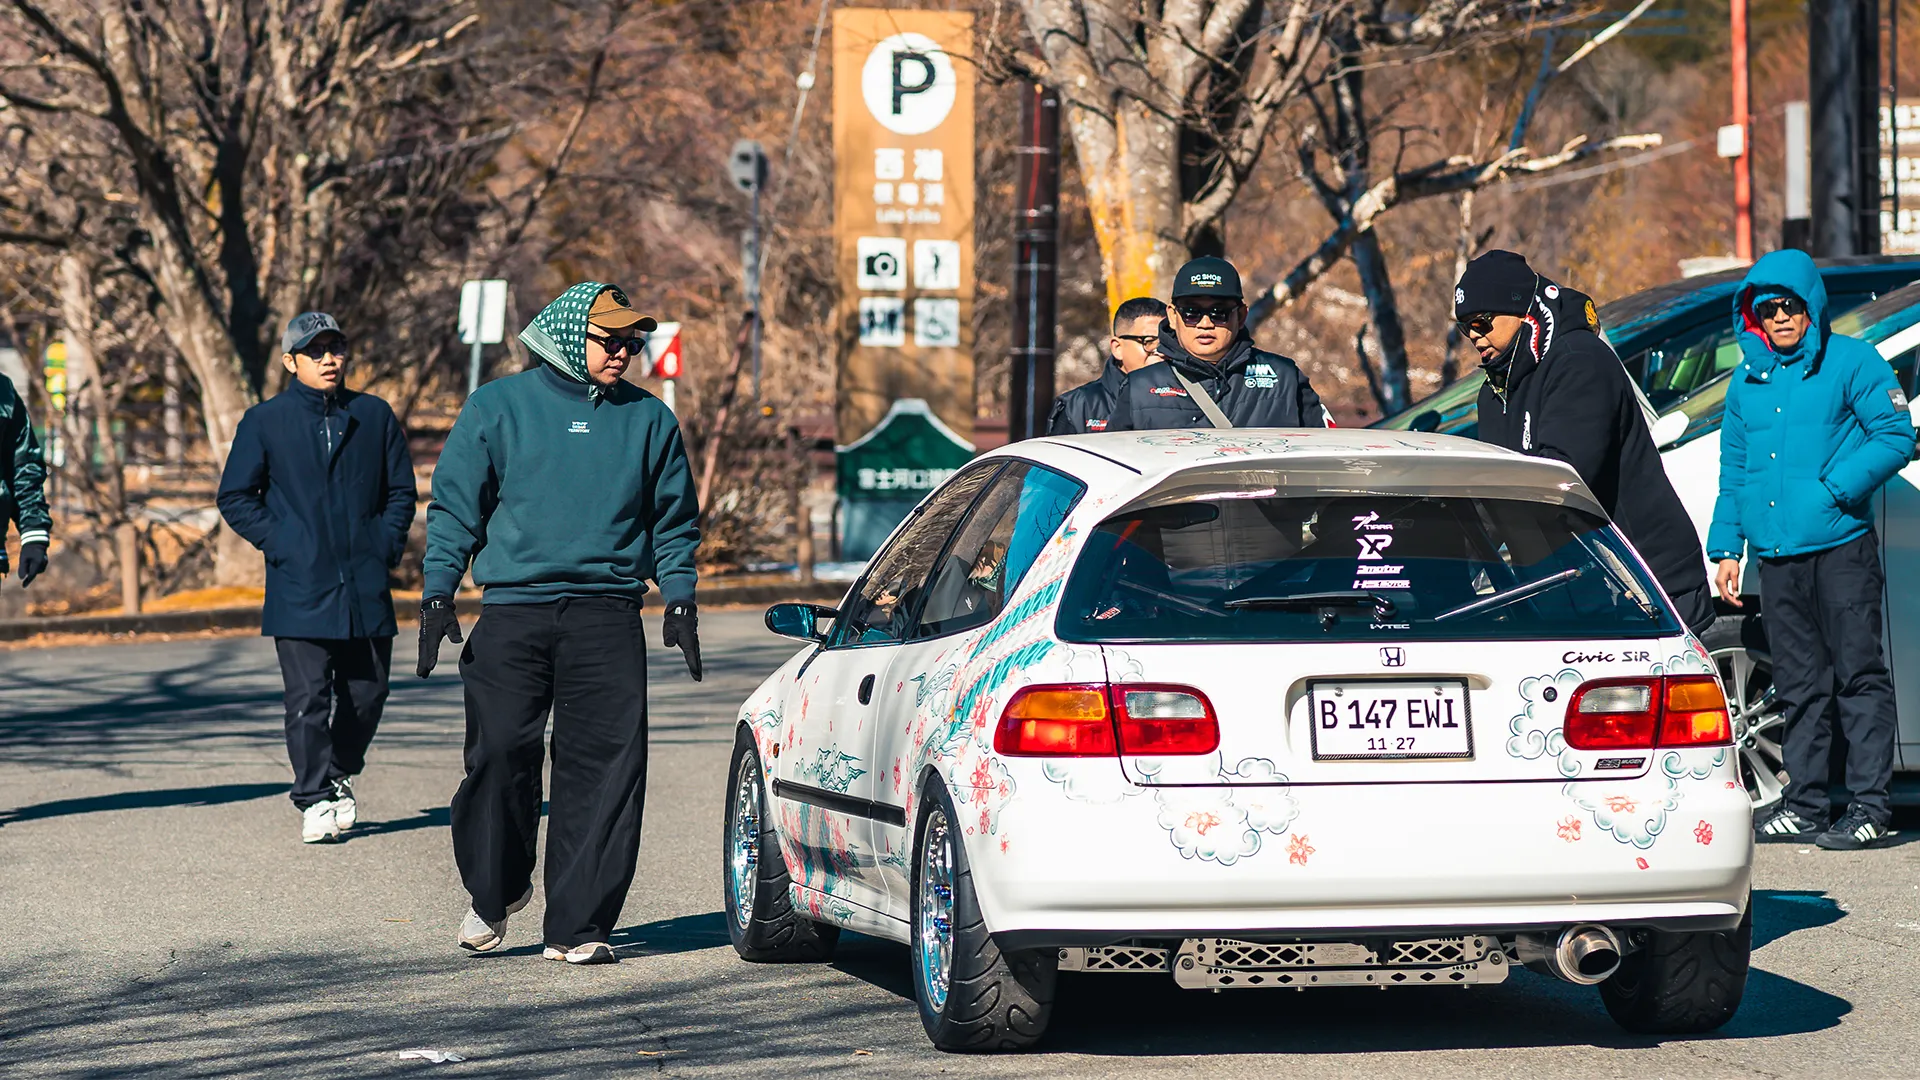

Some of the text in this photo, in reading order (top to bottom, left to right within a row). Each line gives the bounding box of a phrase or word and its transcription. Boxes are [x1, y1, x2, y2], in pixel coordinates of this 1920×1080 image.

[892, 51, 935, 115] P
[1561, 651, 1651, 664] Civic SiR
[1320, 698, 1459, 729] B 147 EWI
